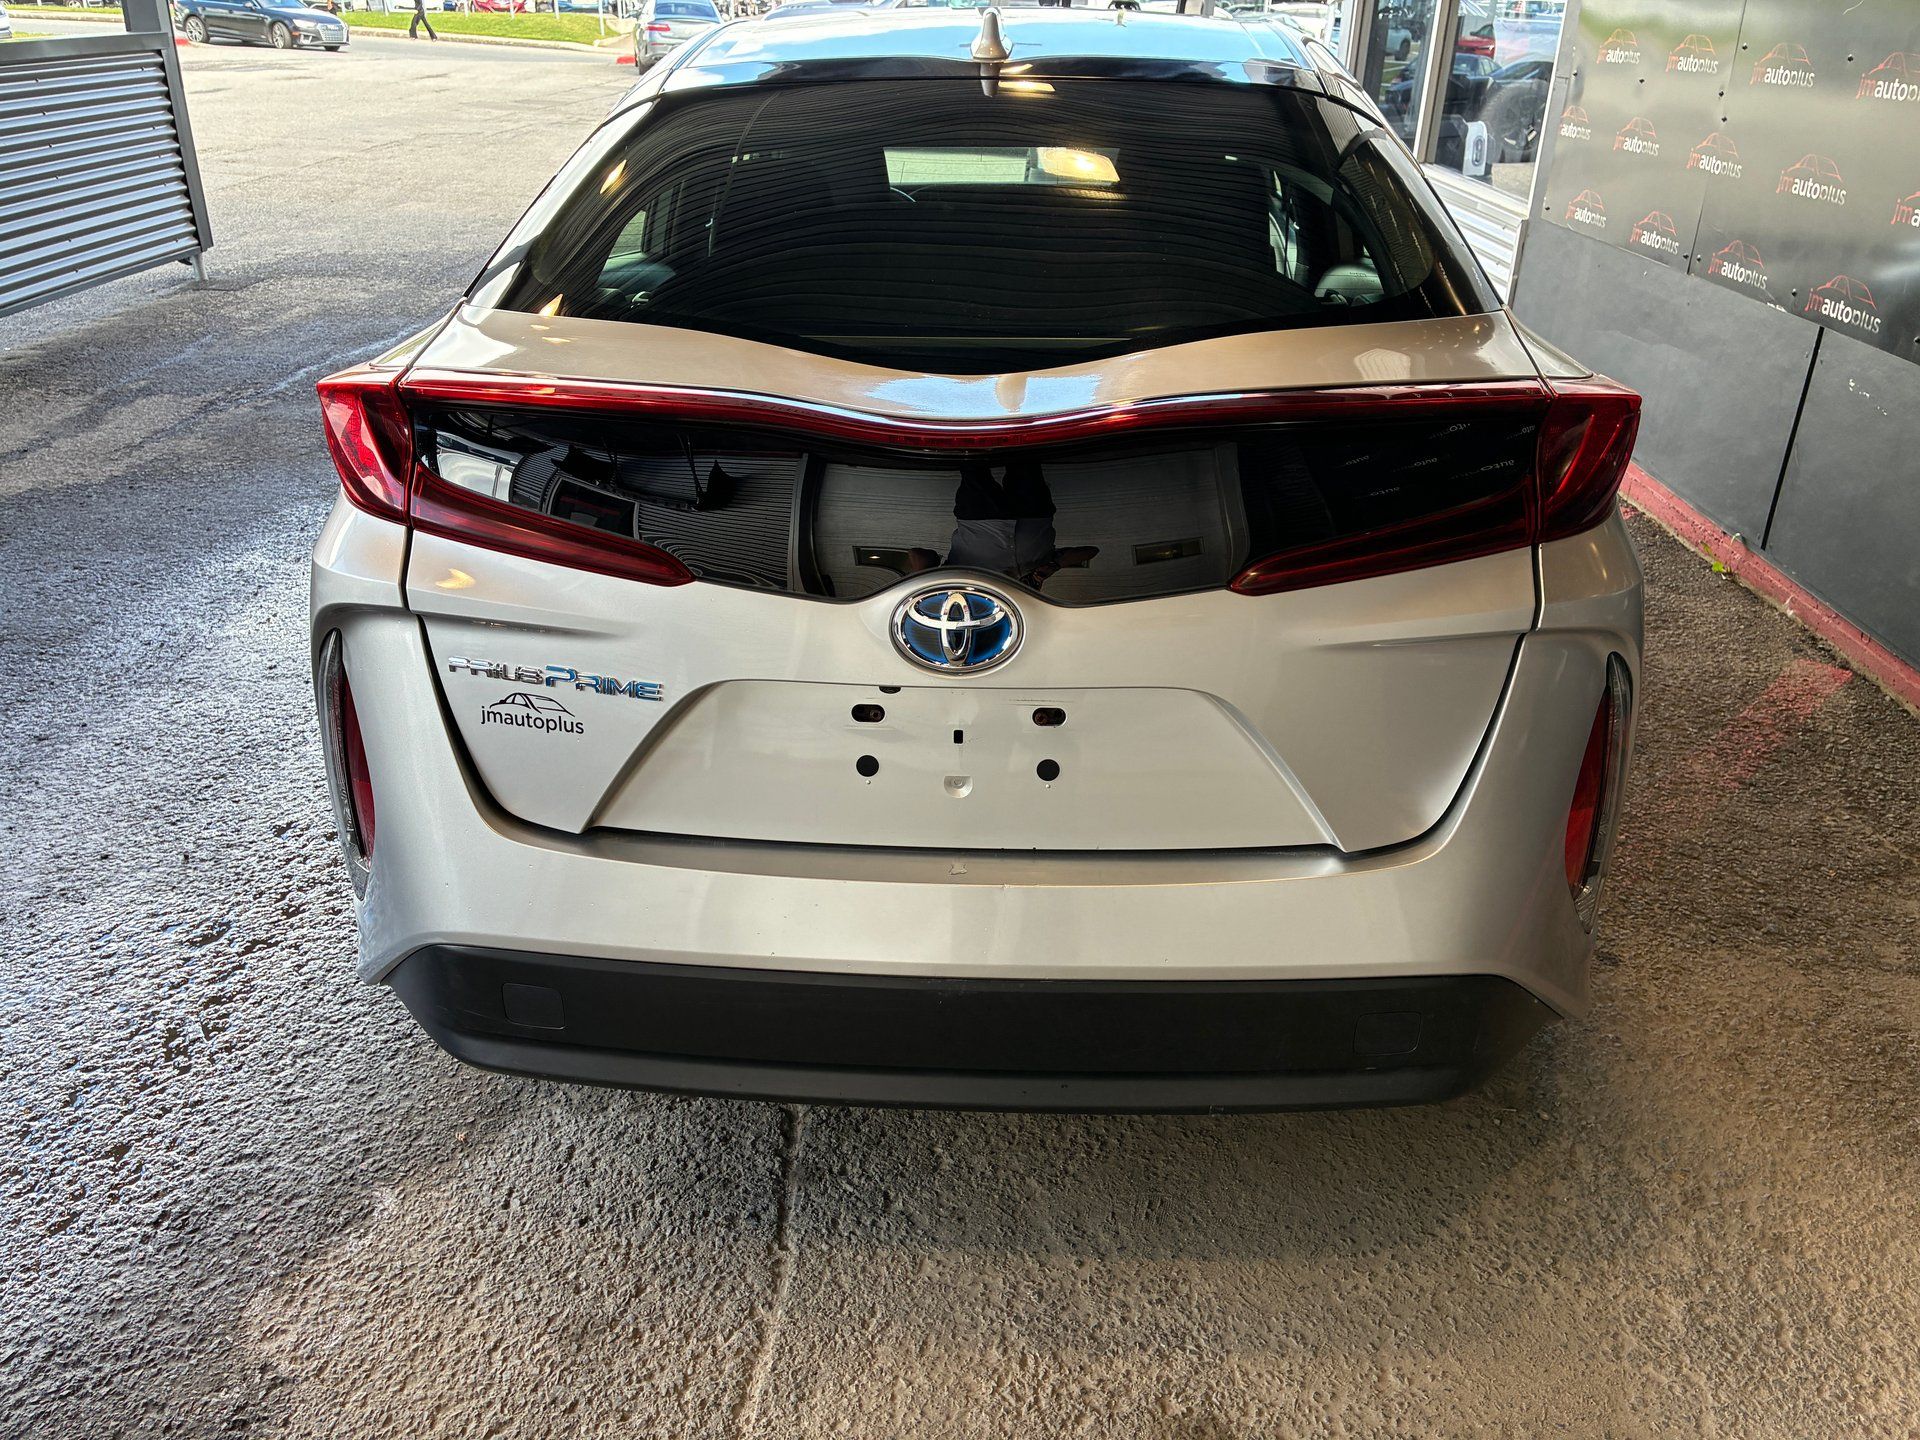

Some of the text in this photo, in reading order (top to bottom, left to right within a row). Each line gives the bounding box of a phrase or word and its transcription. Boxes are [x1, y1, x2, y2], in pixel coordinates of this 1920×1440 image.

[1665, 52, 1719, 74] jmautoplus
[1750, 61, 1815, 88] jmautoplus
[1686, 148, 1742, 179] jmautoplus
[1776, 170, 1847, 206] jmautoplus
[1708, 252, 1768, 290] jmautoplus
[1804, 287, 1881, 334] jmautoplus
[481, 706, 584, 734] jmautoplus
